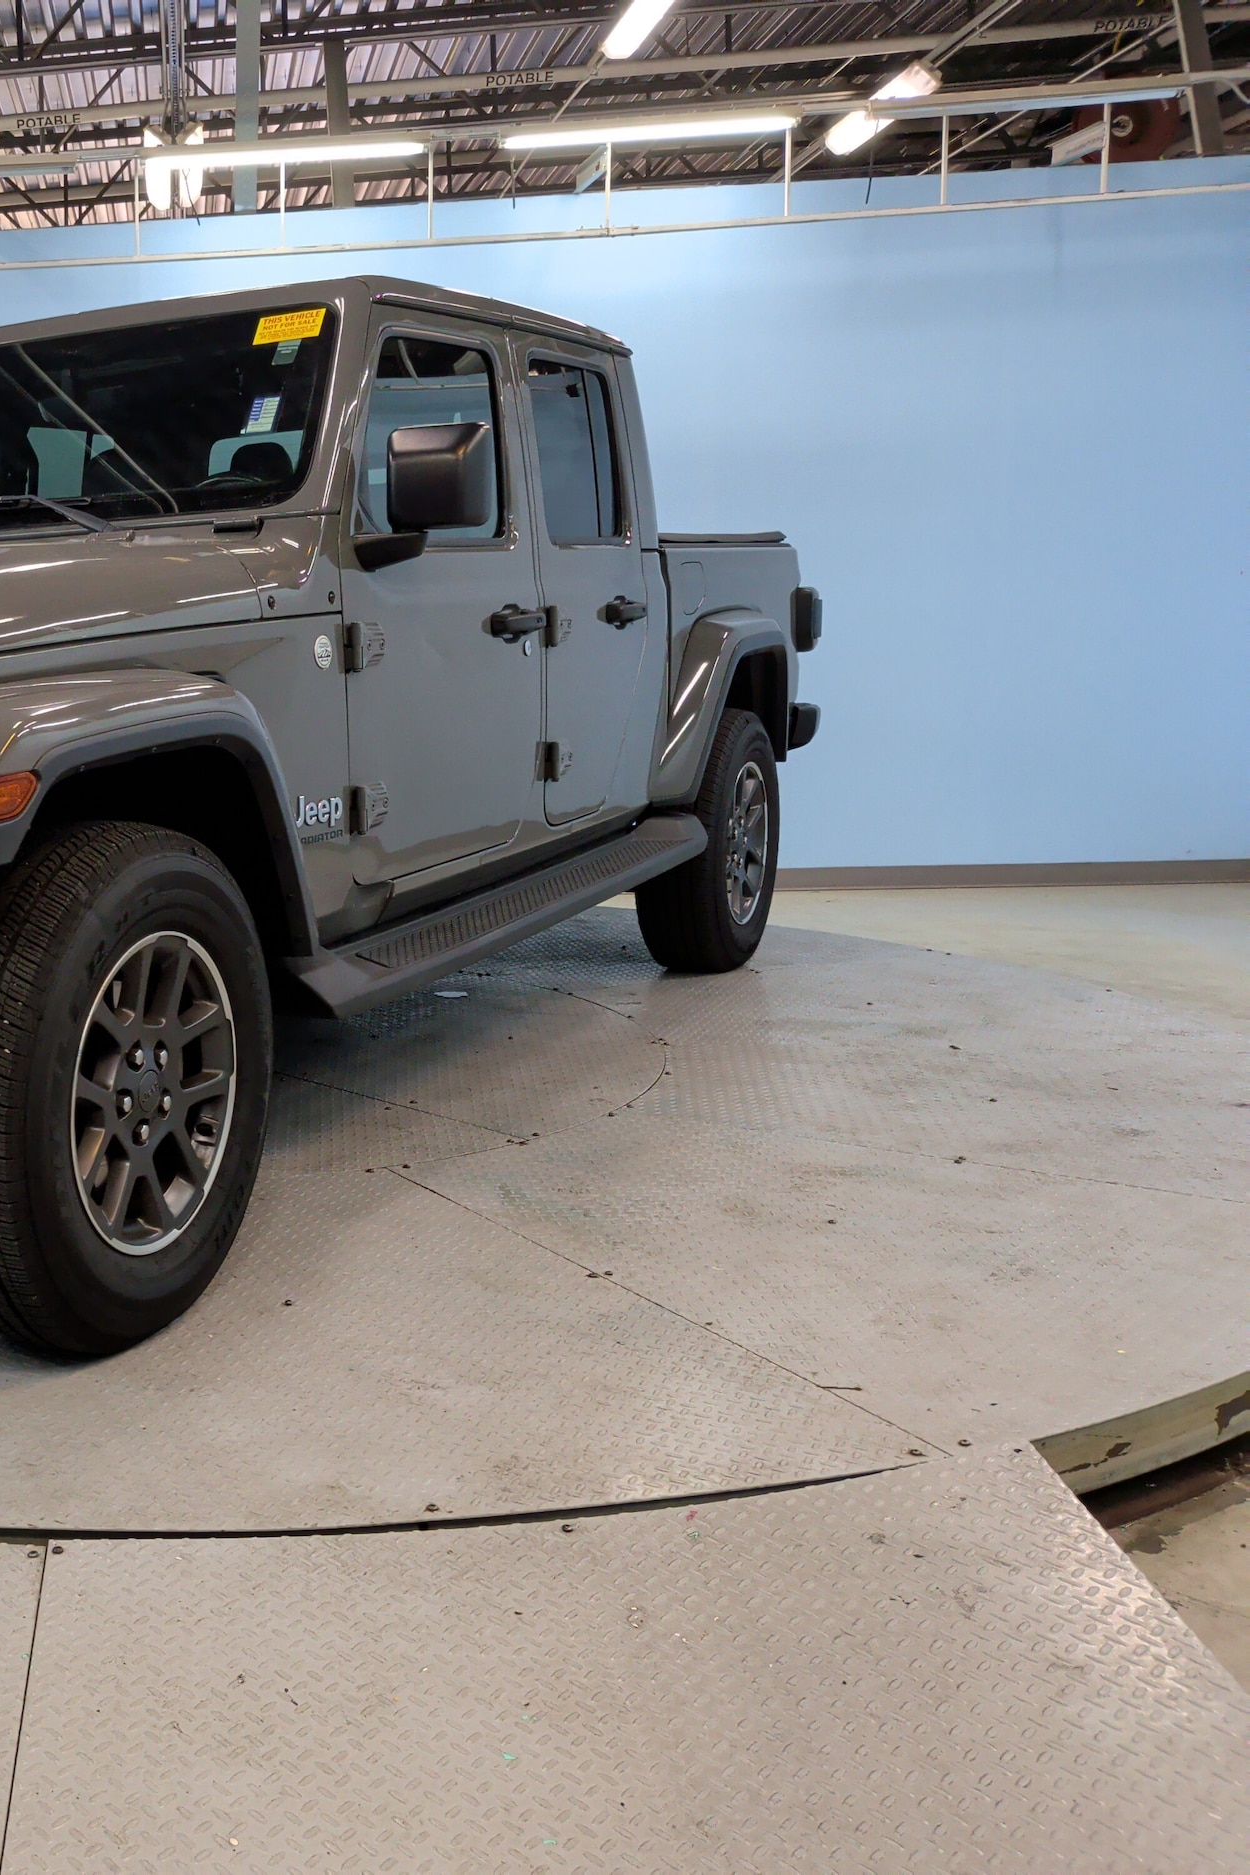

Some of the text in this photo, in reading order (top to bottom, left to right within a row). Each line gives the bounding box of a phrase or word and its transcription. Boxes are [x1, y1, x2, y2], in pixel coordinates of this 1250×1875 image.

[486, 71, 554, 87] POTABLE
[17, 113, 81, 129] POTABLE
[262, 318, 317, 331] NOT FOR SALE
[263, 310, 322, 325] THIS VEHICLE
[295, 795, 343, 828] Jeep
[301, 829, 343, 845] ADIATOR
